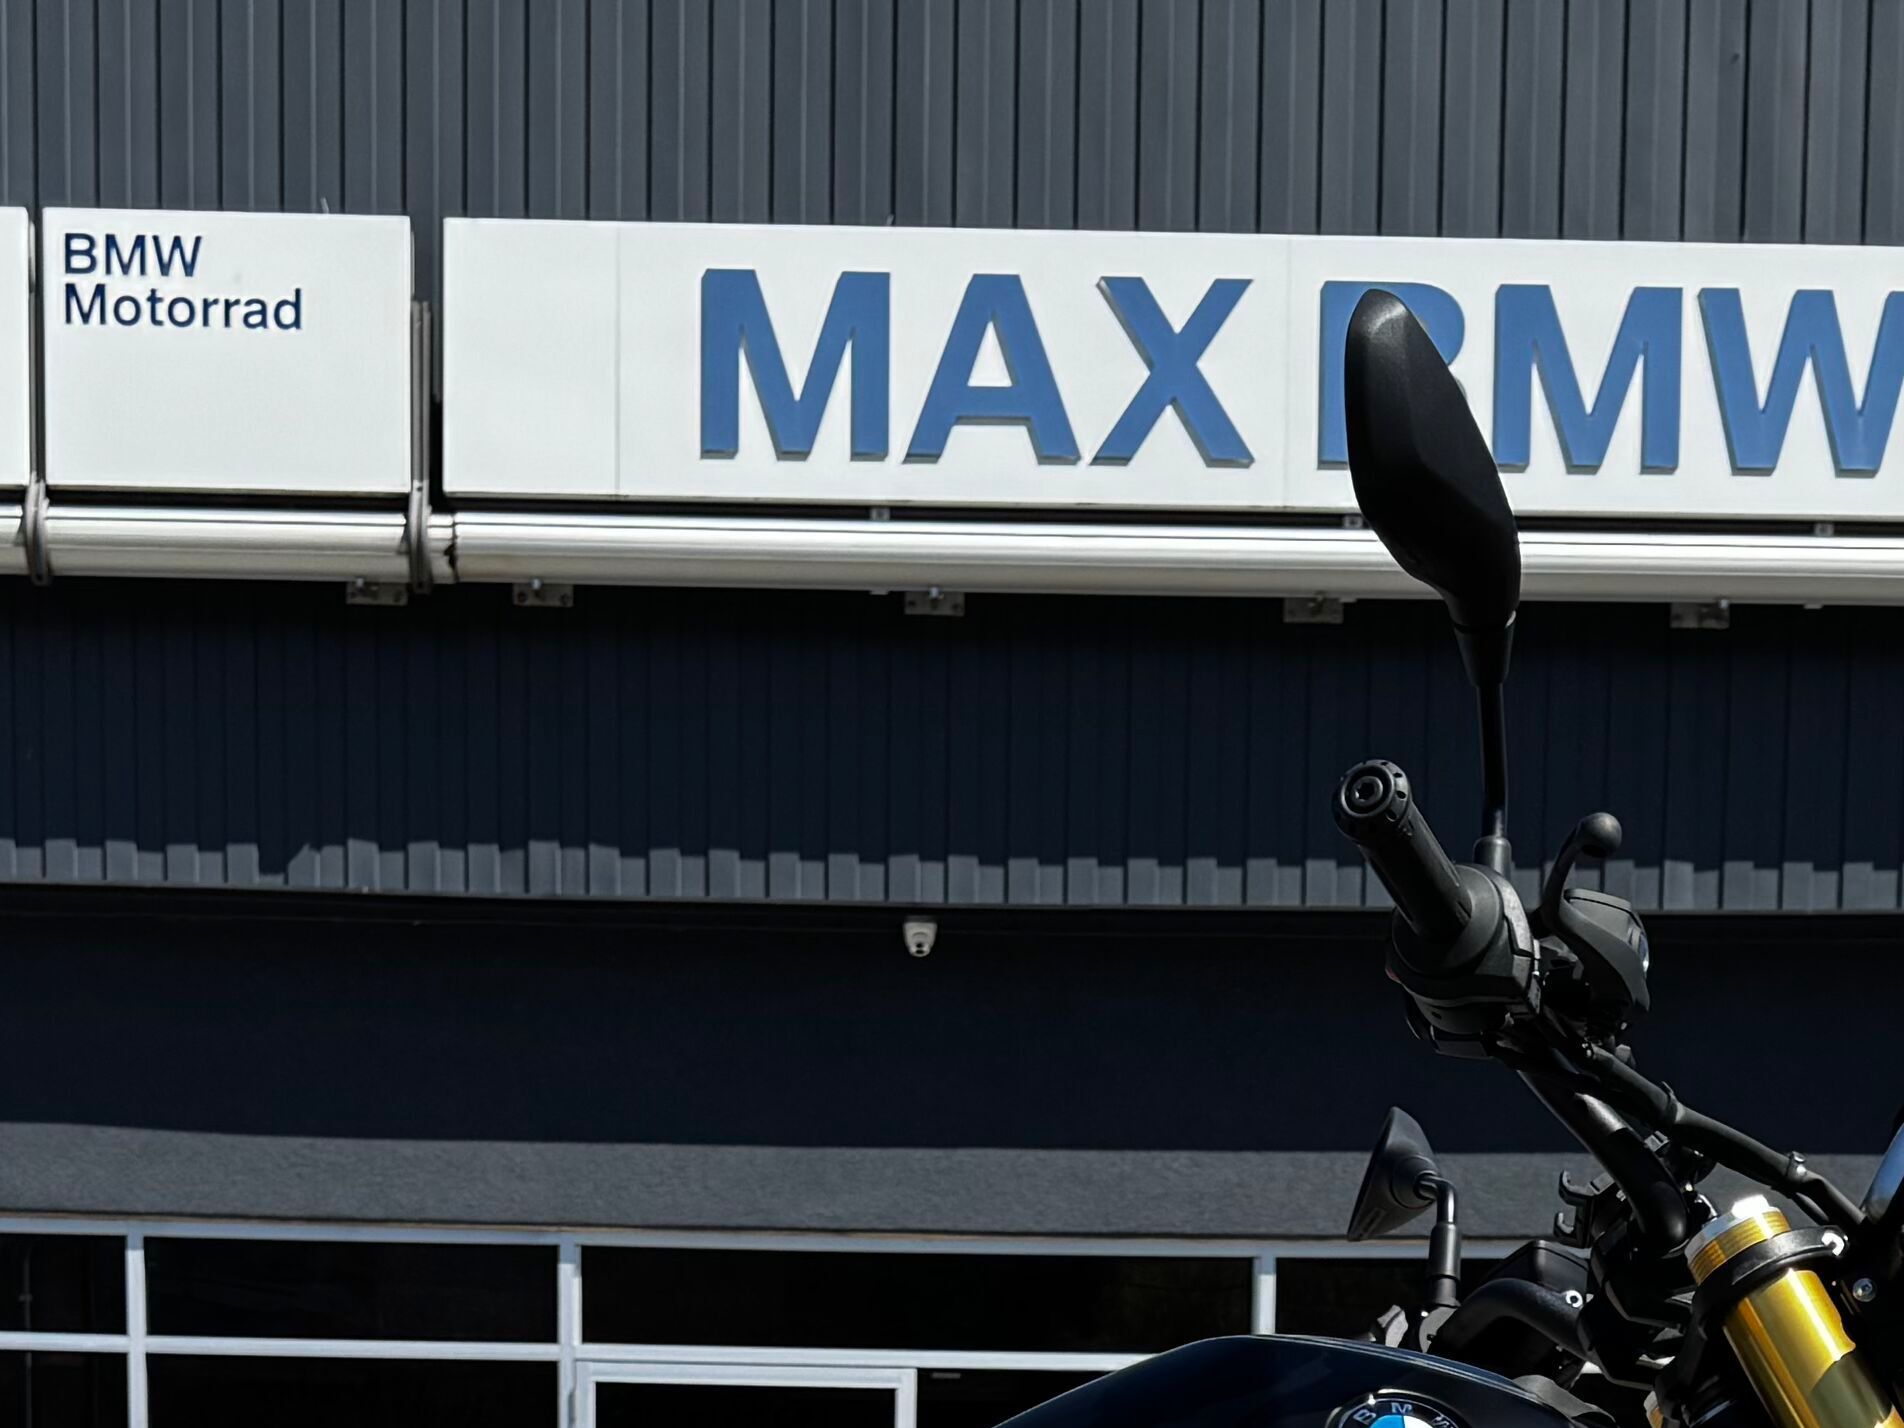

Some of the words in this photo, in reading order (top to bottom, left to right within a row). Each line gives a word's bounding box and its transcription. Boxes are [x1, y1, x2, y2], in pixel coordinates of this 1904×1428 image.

[64, 232, 203, 278] BMW
[63, 284, 302, 330] Motorrad
[699, 268, 1256, 466] MAX
